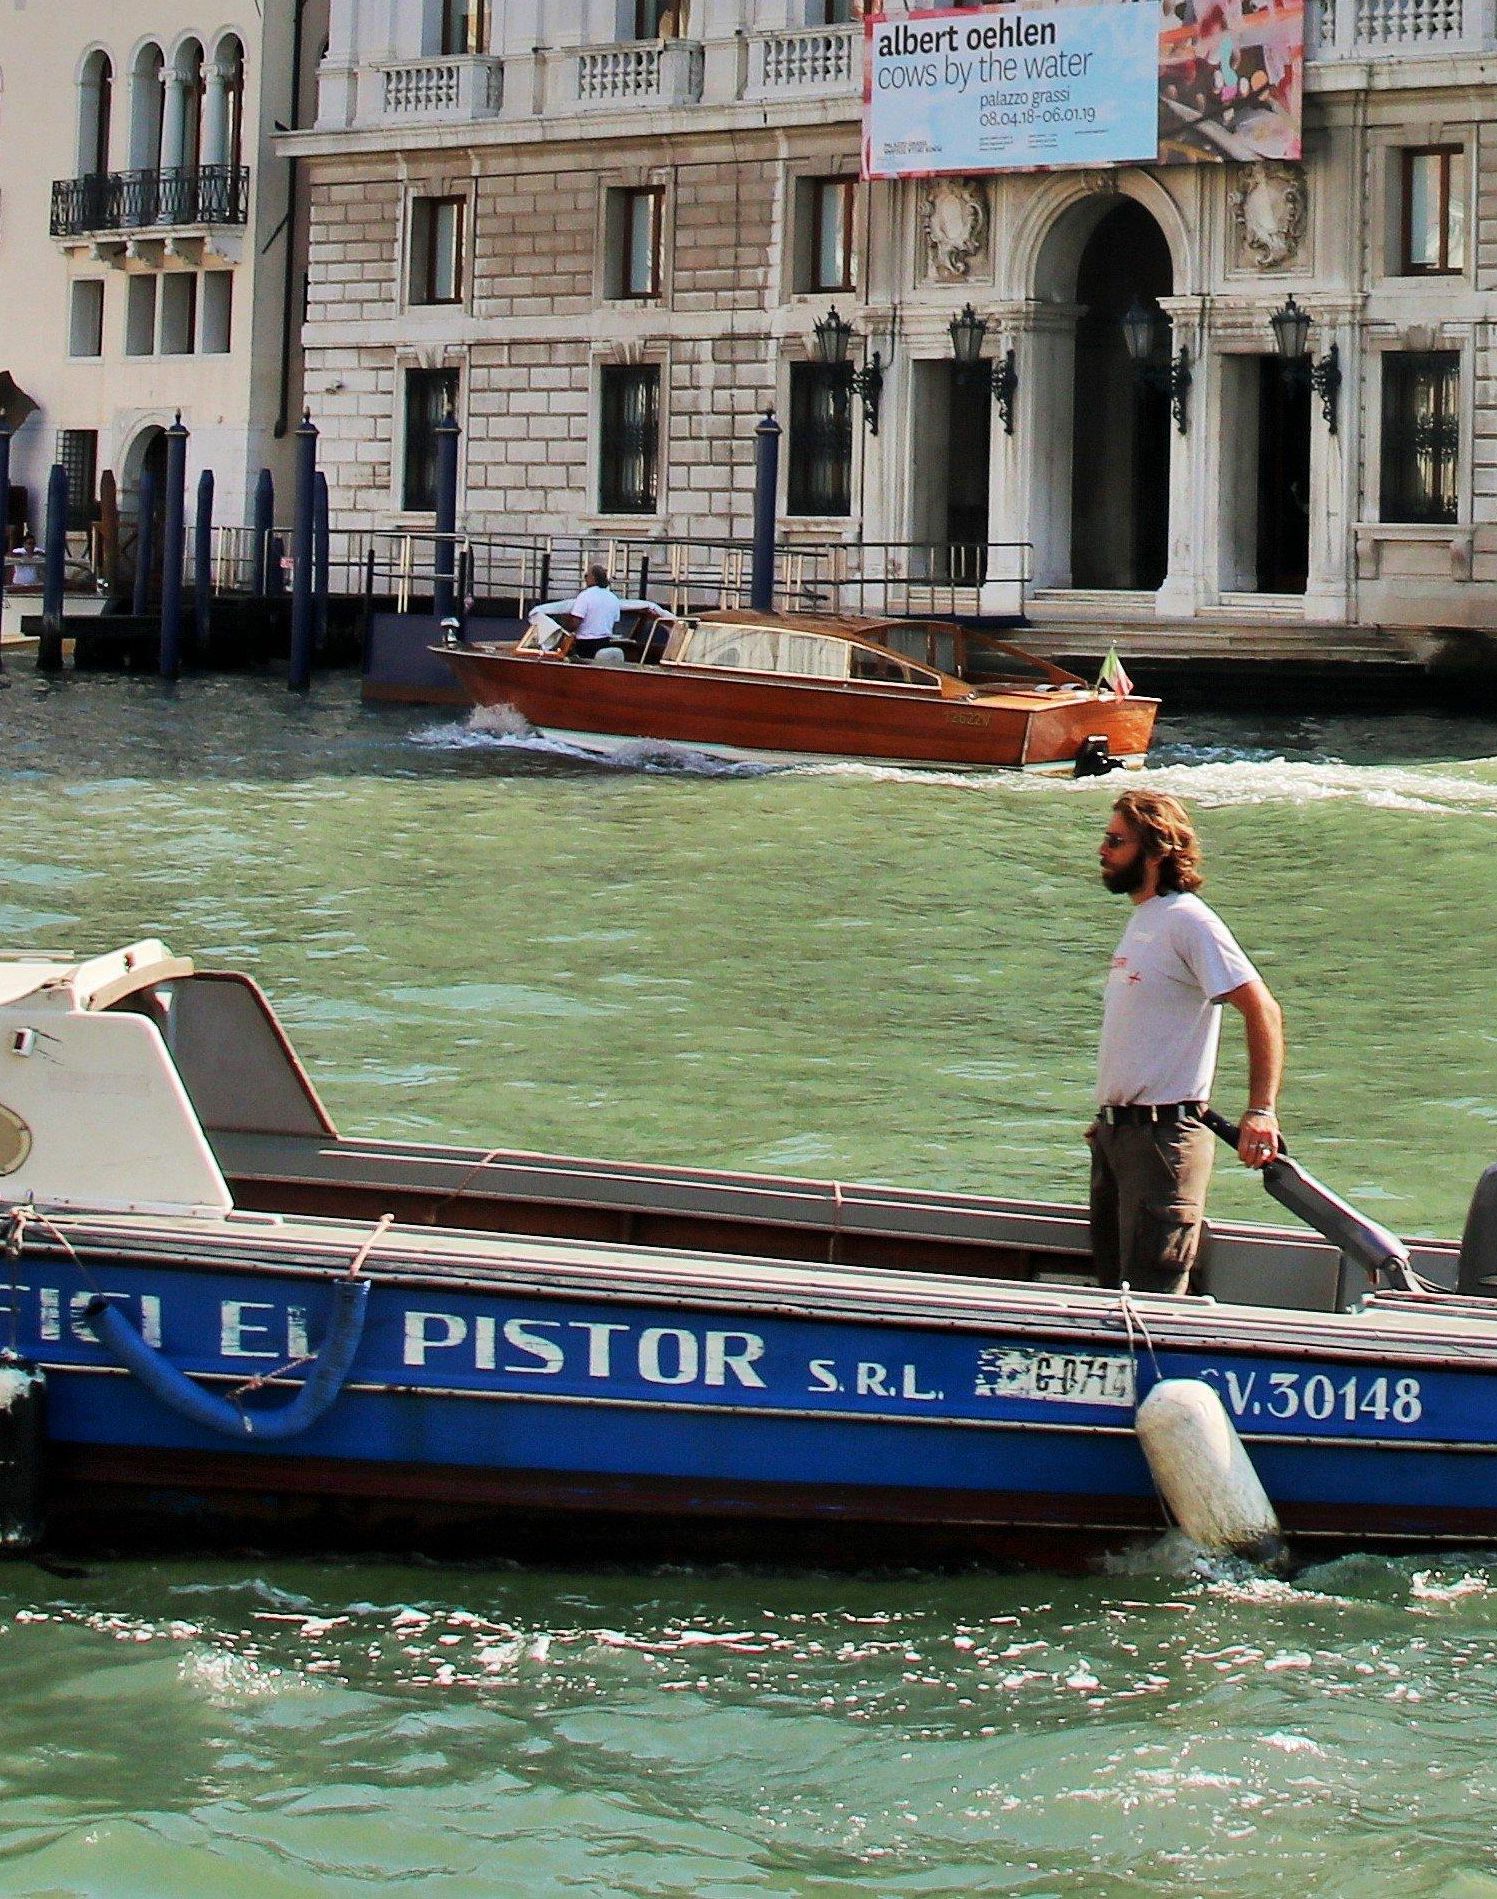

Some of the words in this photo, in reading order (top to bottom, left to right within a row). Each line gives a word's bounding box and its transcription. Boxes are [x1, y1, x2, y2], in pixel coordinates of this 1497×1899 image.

[878, 24, 959, 57] albert
[966, 16, 1056, 51] oehlen
[878, 63, 937, 90] cows
[945, 54, 973, 93] by
[979, 51, 1018, 83] the
[1024, 50, 1094, 80] water
[980, 90, 1029, 110] palazzo
[1031, 85, 1071, 109] grassi
[403, 1309, 768, 1390] PISTOR
[807, 1358, 945, 1401] S.R.L.
[1200, 1367, 1424, 1425] V.30148
